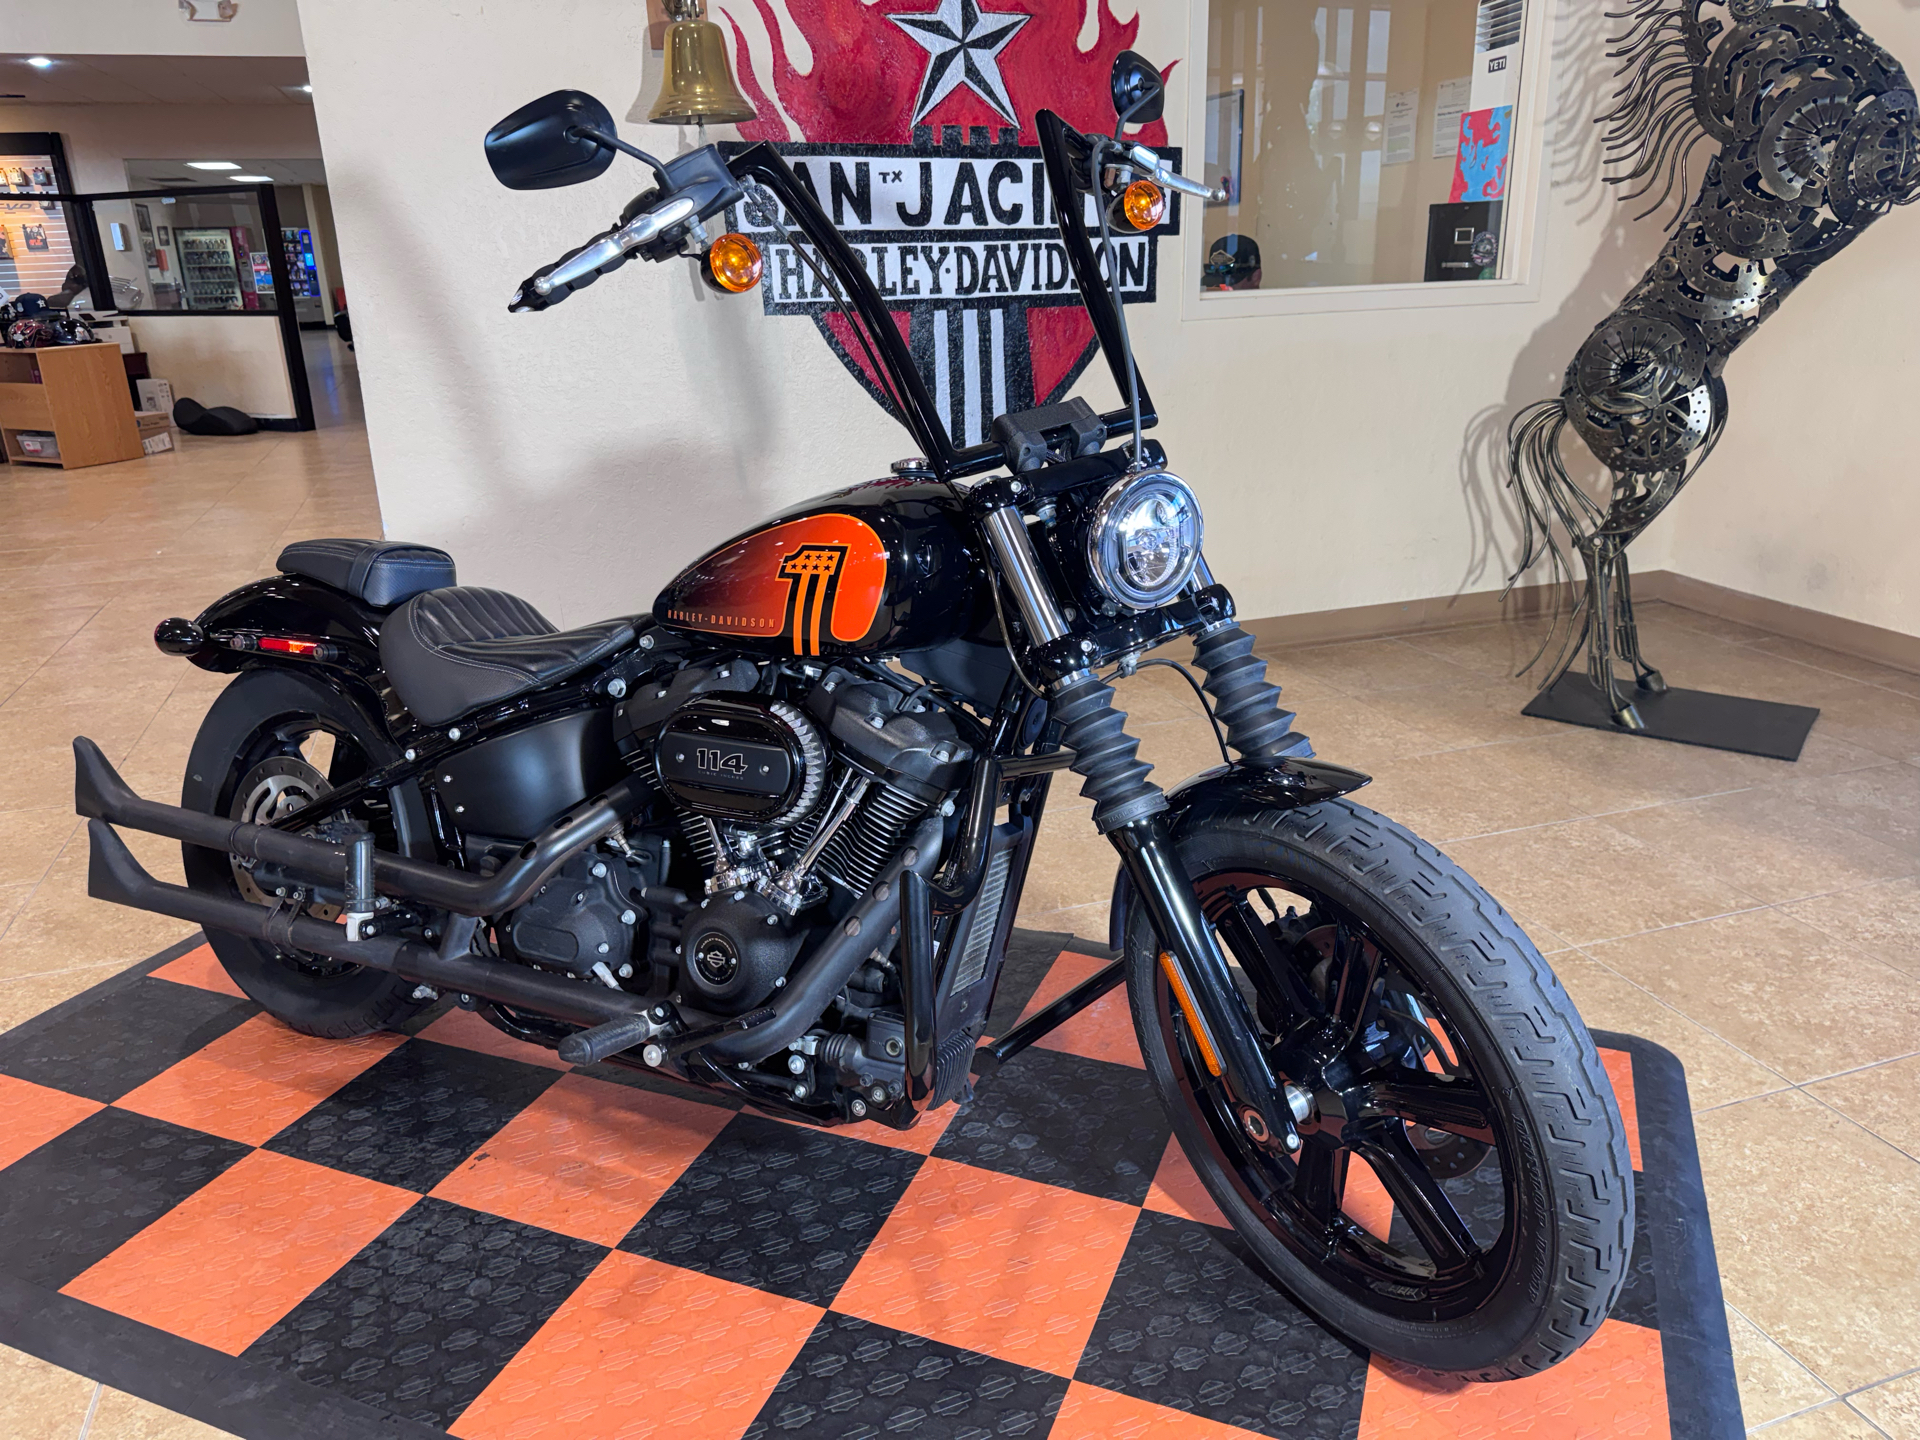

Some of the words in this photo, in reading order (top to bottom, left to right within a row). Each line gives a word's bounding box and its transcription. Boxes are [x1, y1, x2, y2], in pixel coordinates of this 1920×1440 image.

[1489, 57, 1506, 71] YETI
[879, 170, 903, 184] TX
[667, 609, 776, 628] HARLEY-DAVIDSON
[696, 748, 749, 775] 114
[1512, 1113, 1548, 1229] DUNLOP
